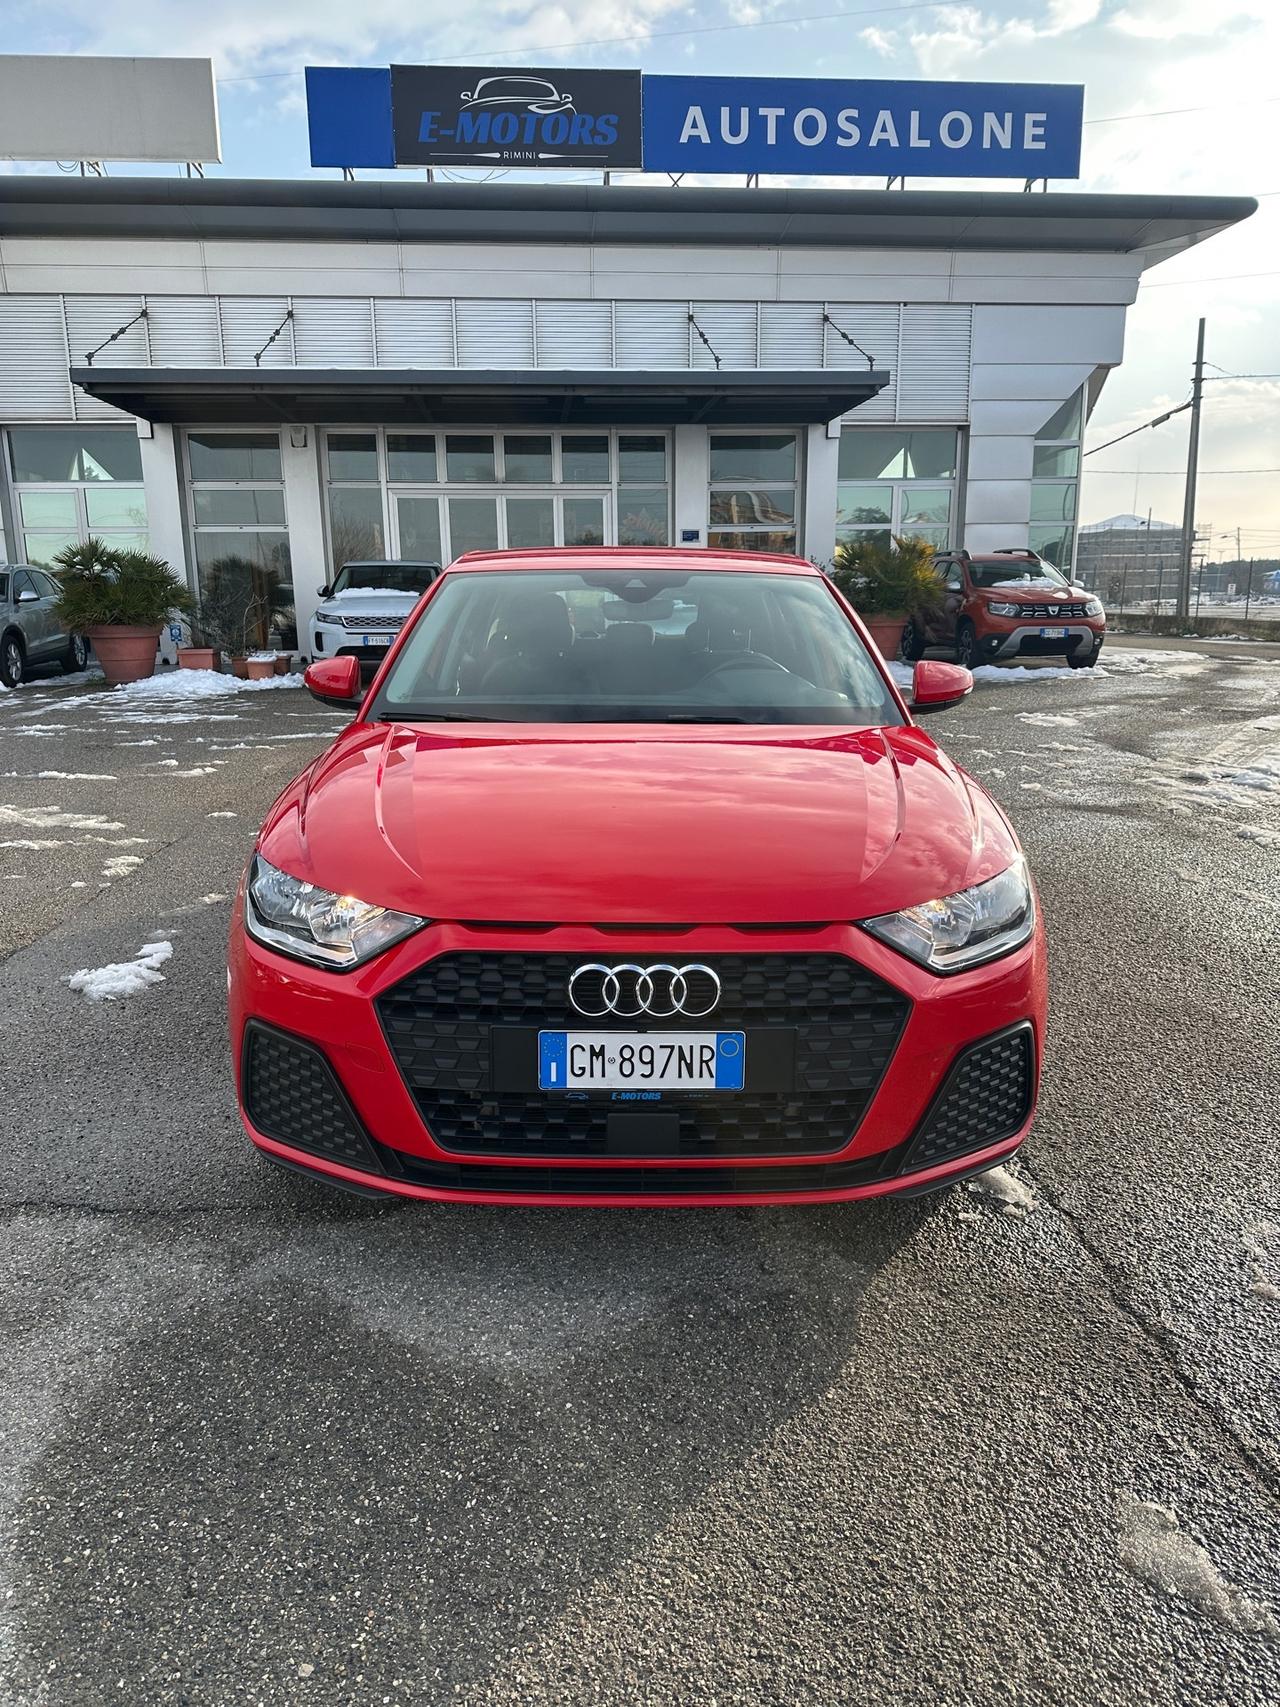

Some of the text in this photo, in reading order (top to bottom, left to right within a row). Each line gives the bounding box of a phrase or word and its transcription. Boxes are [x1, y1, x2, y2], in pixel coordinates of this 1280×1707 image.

[418, 110, 619, 146] E-MOTORS
[679, 105, 1048, 150] AUTOSALONE
[503, 150, 537, 160] RIMINI
[619, 1044, 715, 1079] 897NR
[611, 1092, 661, 1100] E-MOTORS
